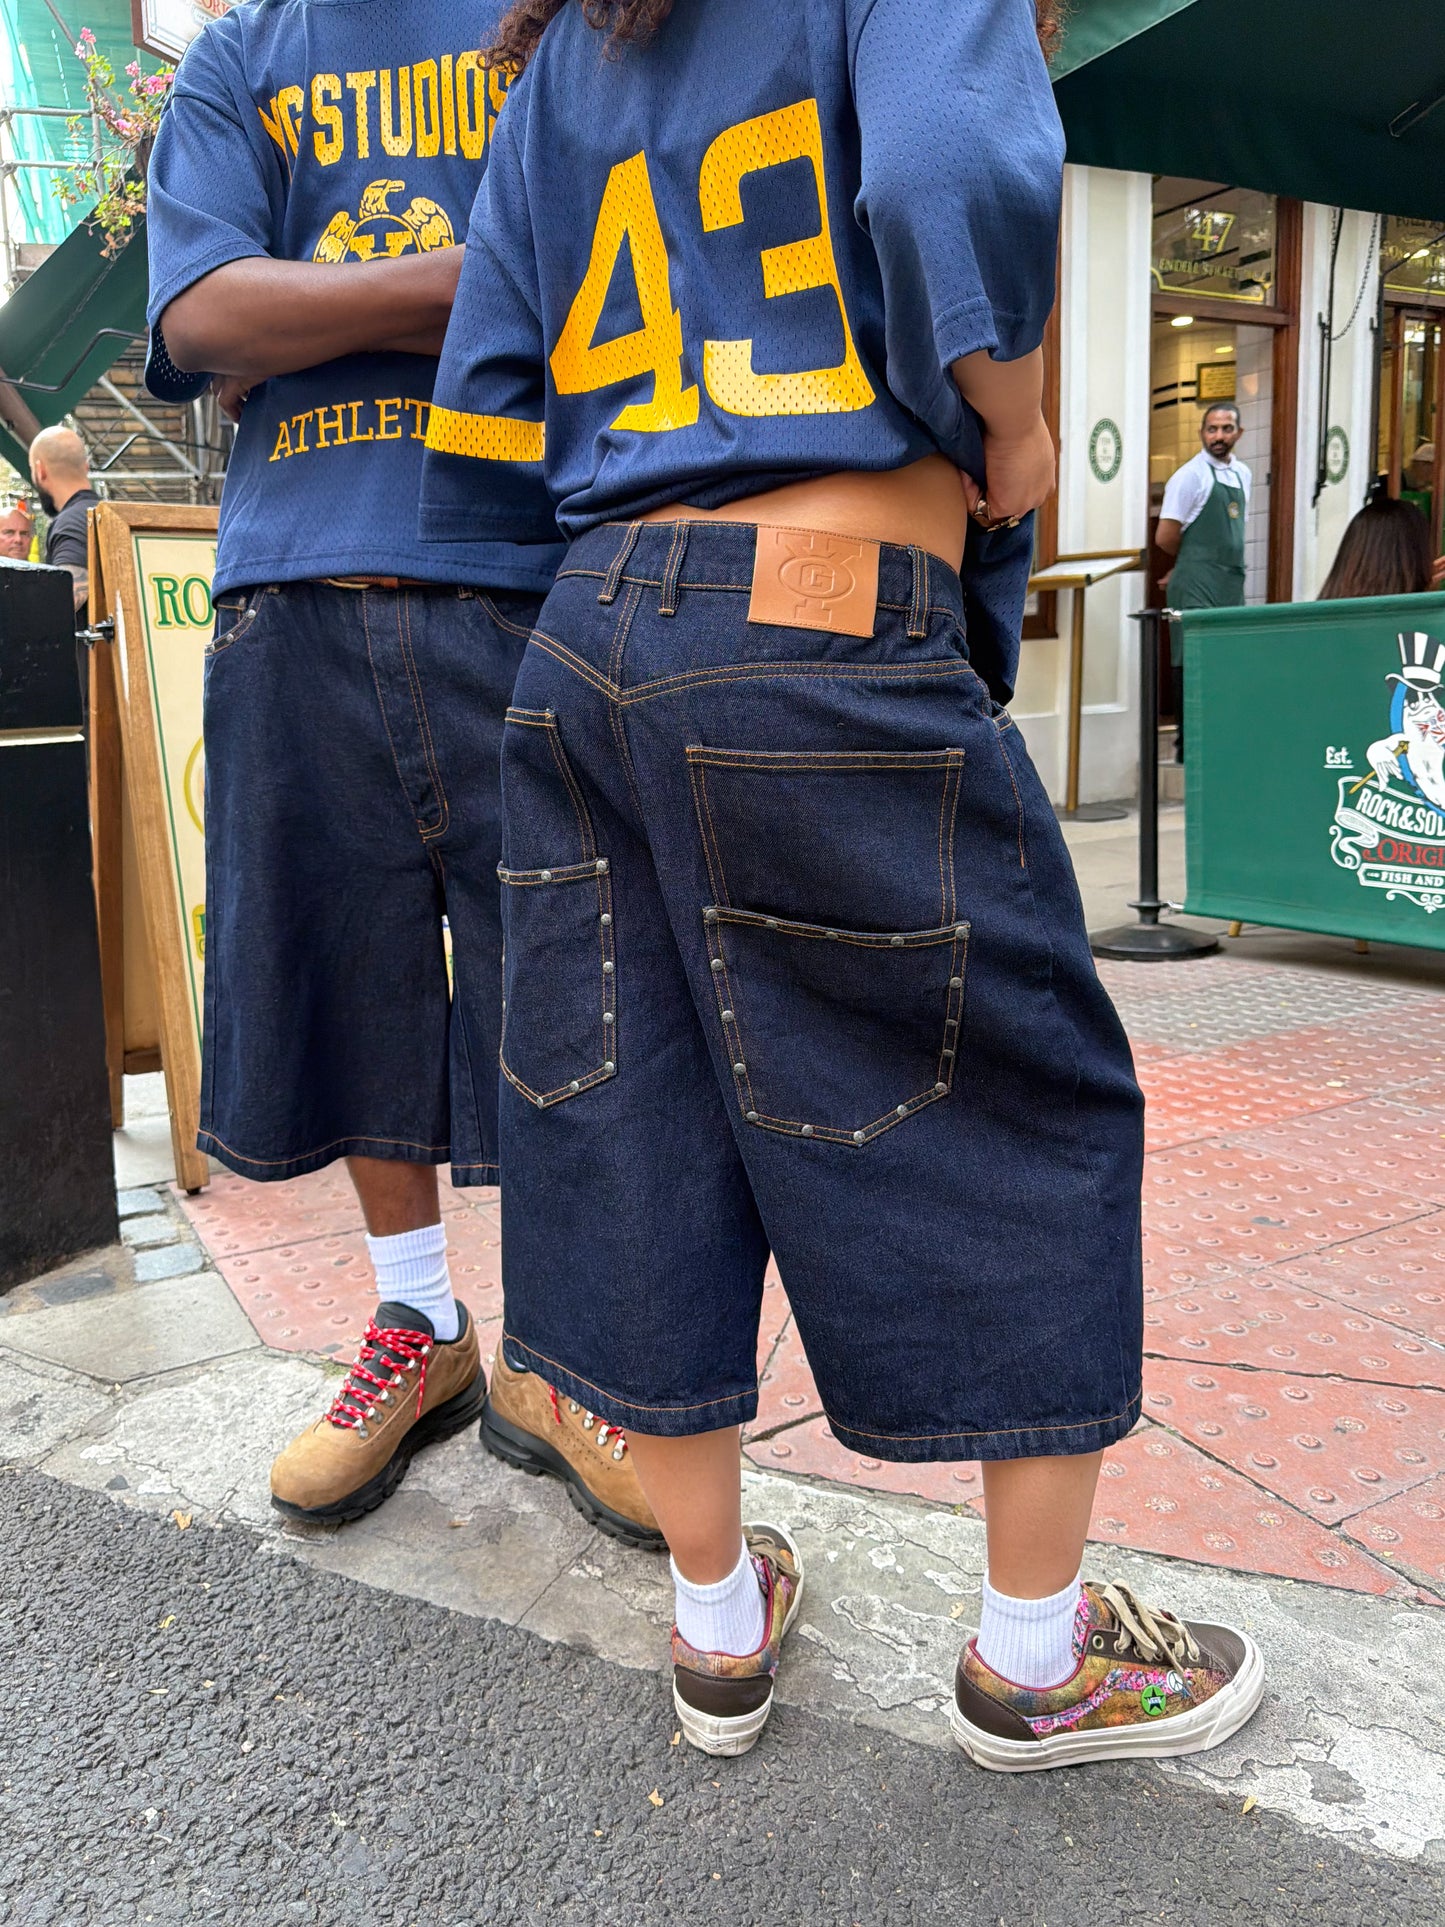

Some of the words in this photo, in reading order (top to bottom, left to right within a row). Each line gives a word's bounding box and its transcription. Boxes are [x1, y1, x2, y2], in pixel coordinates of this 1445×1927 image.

[1191, 211, 1236, 253] 47
[549, 98, 876, 432] 43
[268, 397, 431, 462] ATHLET
[150, 574, 215, 629] RO
[1325, 745, 1353, 765] Est.
[1381, 870, 1413, 885] FISH
[1414, 874, 1445, 887] AND
